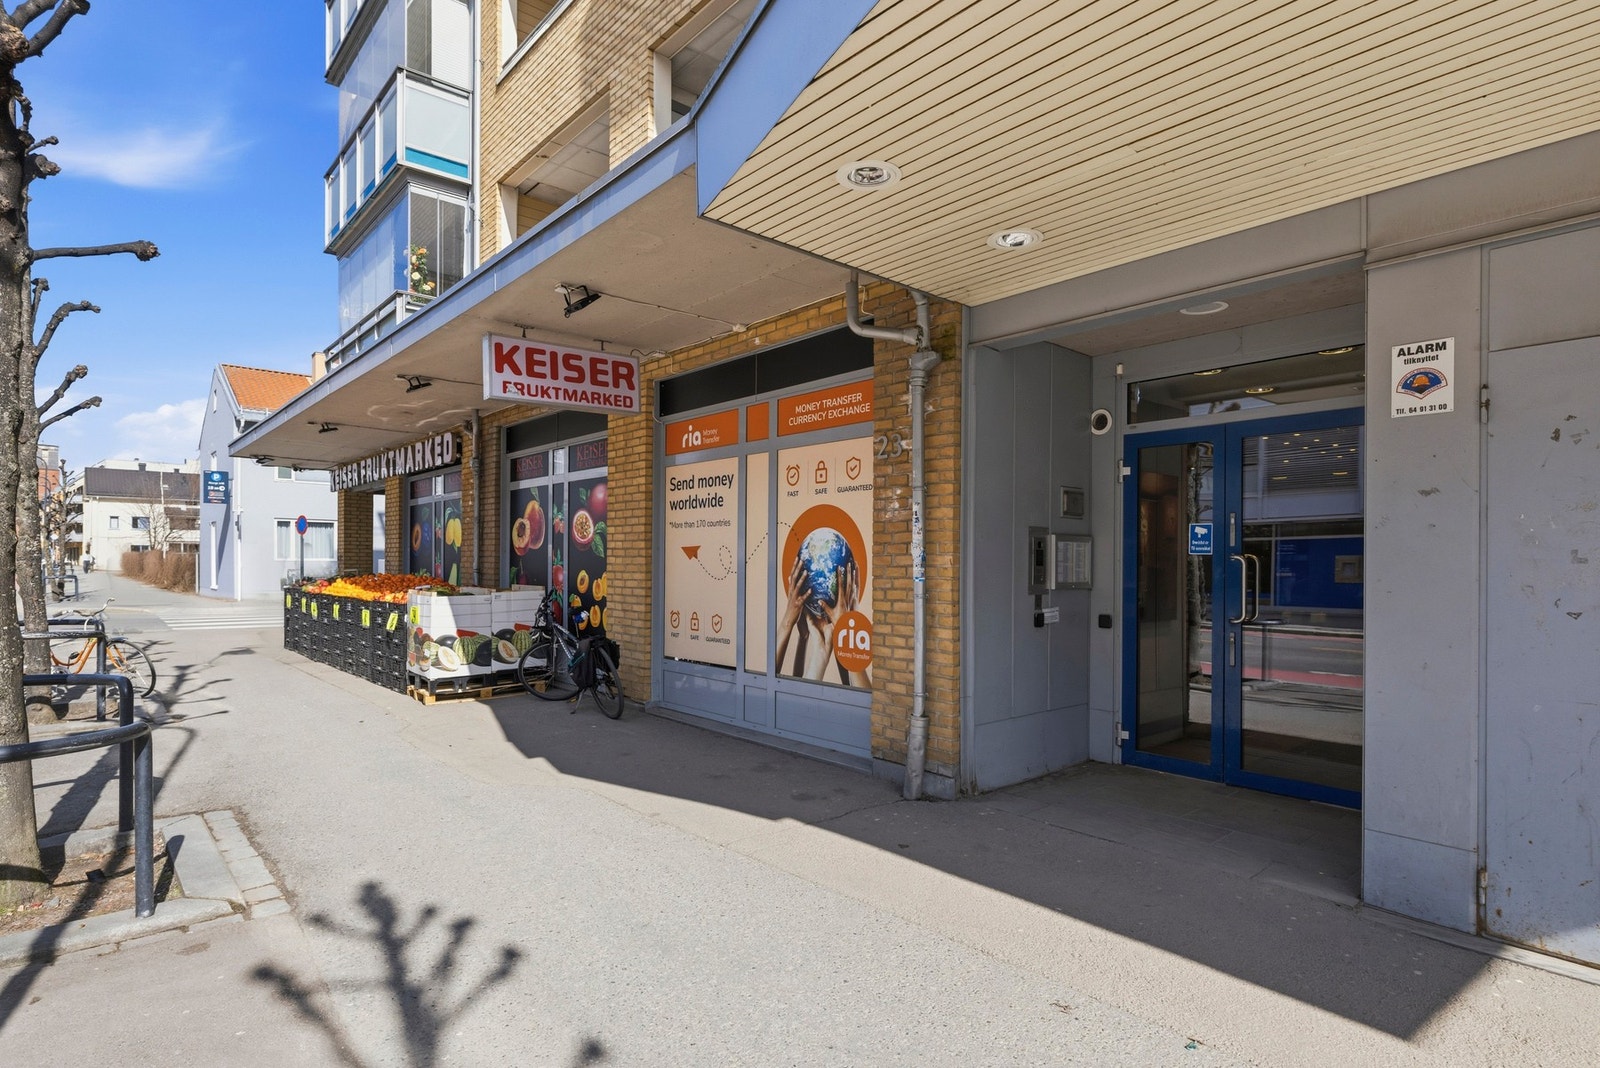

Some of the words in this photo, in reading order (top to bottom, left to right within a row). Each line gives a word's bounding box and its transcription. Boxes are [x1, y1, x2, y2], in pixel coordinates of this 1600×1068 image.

[1397, 341, 1447, 358] ALARM
[1404, 354, 1439, 365] tilknyttet
[494, 342, 636, 391] KEISER
[502, 380, 634, 409] FRUKTMARKED
[795, 400, 821, 414] MONEY
[822, 392, 863, 408] TRANSFER
[788, 412, 827, 426] CURRENCY
[828, 402, 871, 419] EXCHANGE
[682, 424, 701, 448] ria
[874, 433, 903, 460] 23
[329, 462, 358, 492] KEISER
[360, 432, 453, 485] FRUKTMARKED
[669, 474, 695, 491] Send
[698, 473, 734, 489] money
[837, 483, 873, 493] GUARANTEED
[669, 492, 724, 511] worldwide
[684, 520, 695, 528] than
[696, 519, 706, 528] 170
[707, 518, 731, 528] countries
[837, 618, 870, 651] ria
